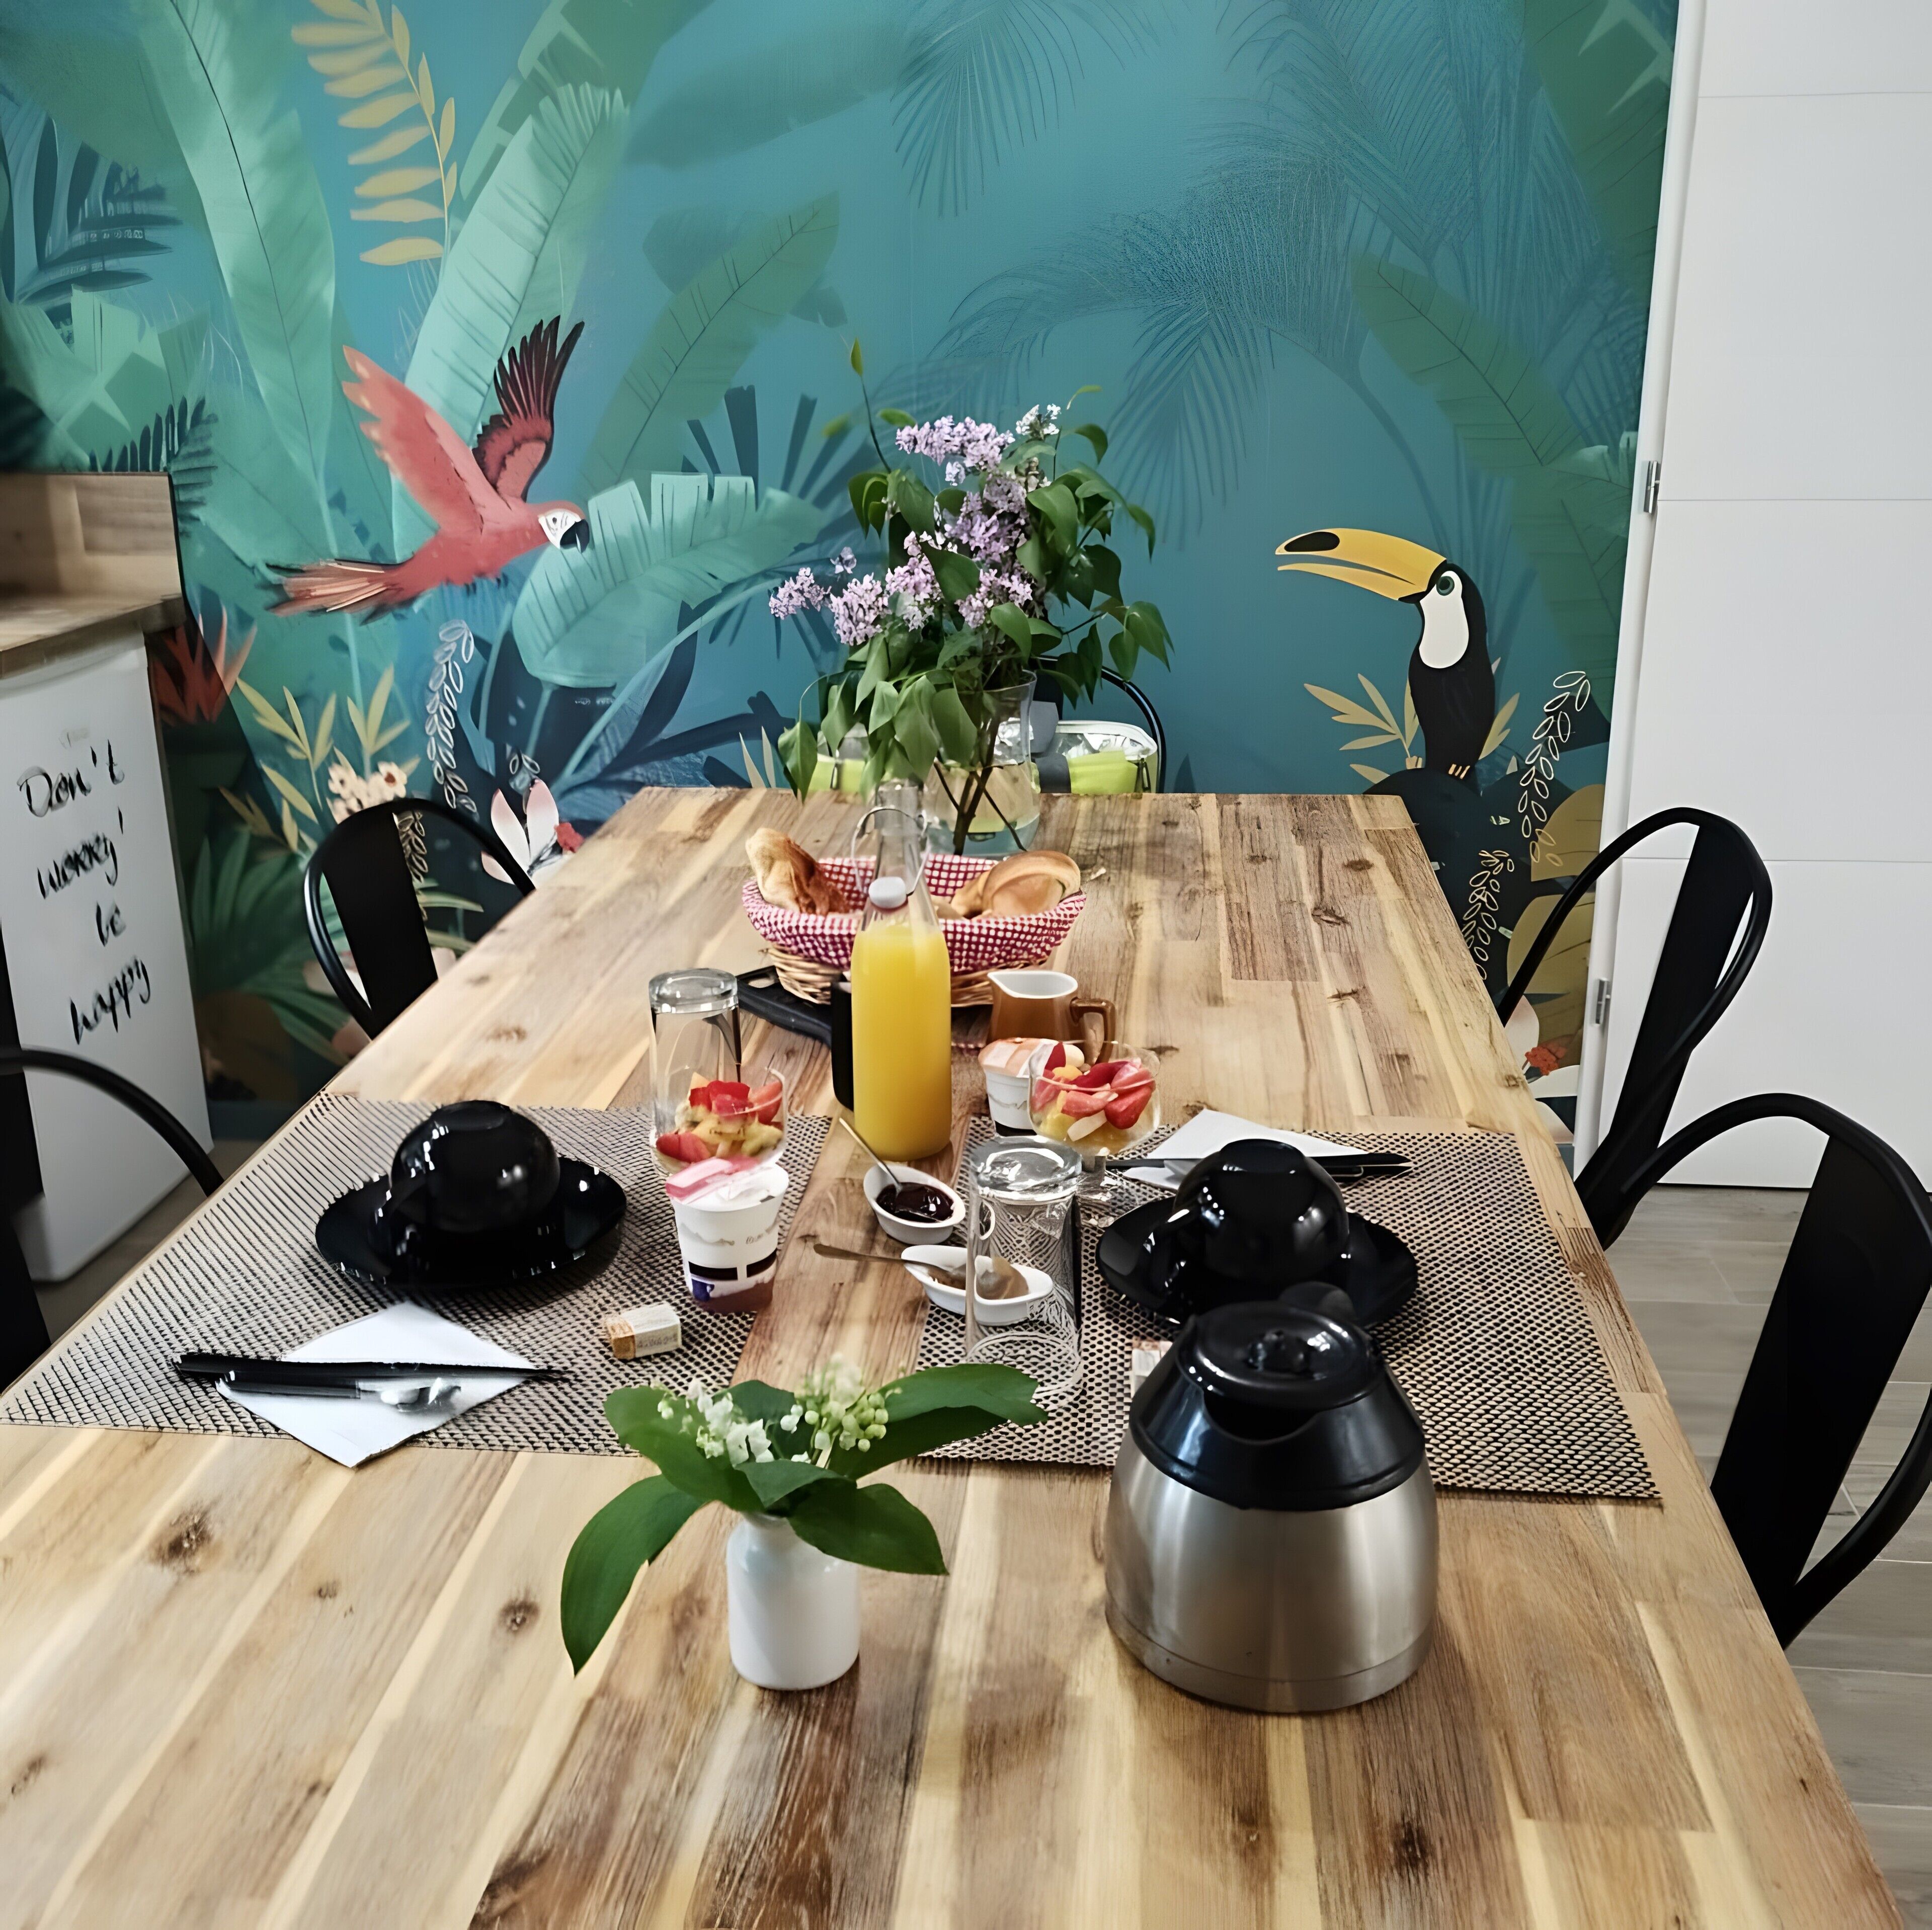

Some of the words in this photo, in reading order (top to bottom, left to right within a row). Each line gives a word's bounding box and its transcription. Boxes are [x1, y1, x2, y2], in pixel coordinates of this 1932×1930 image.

[17, 739, 125, 818] Don't
[95, 901, 126, 947] be
[69, 956, 151, 1046] happy
